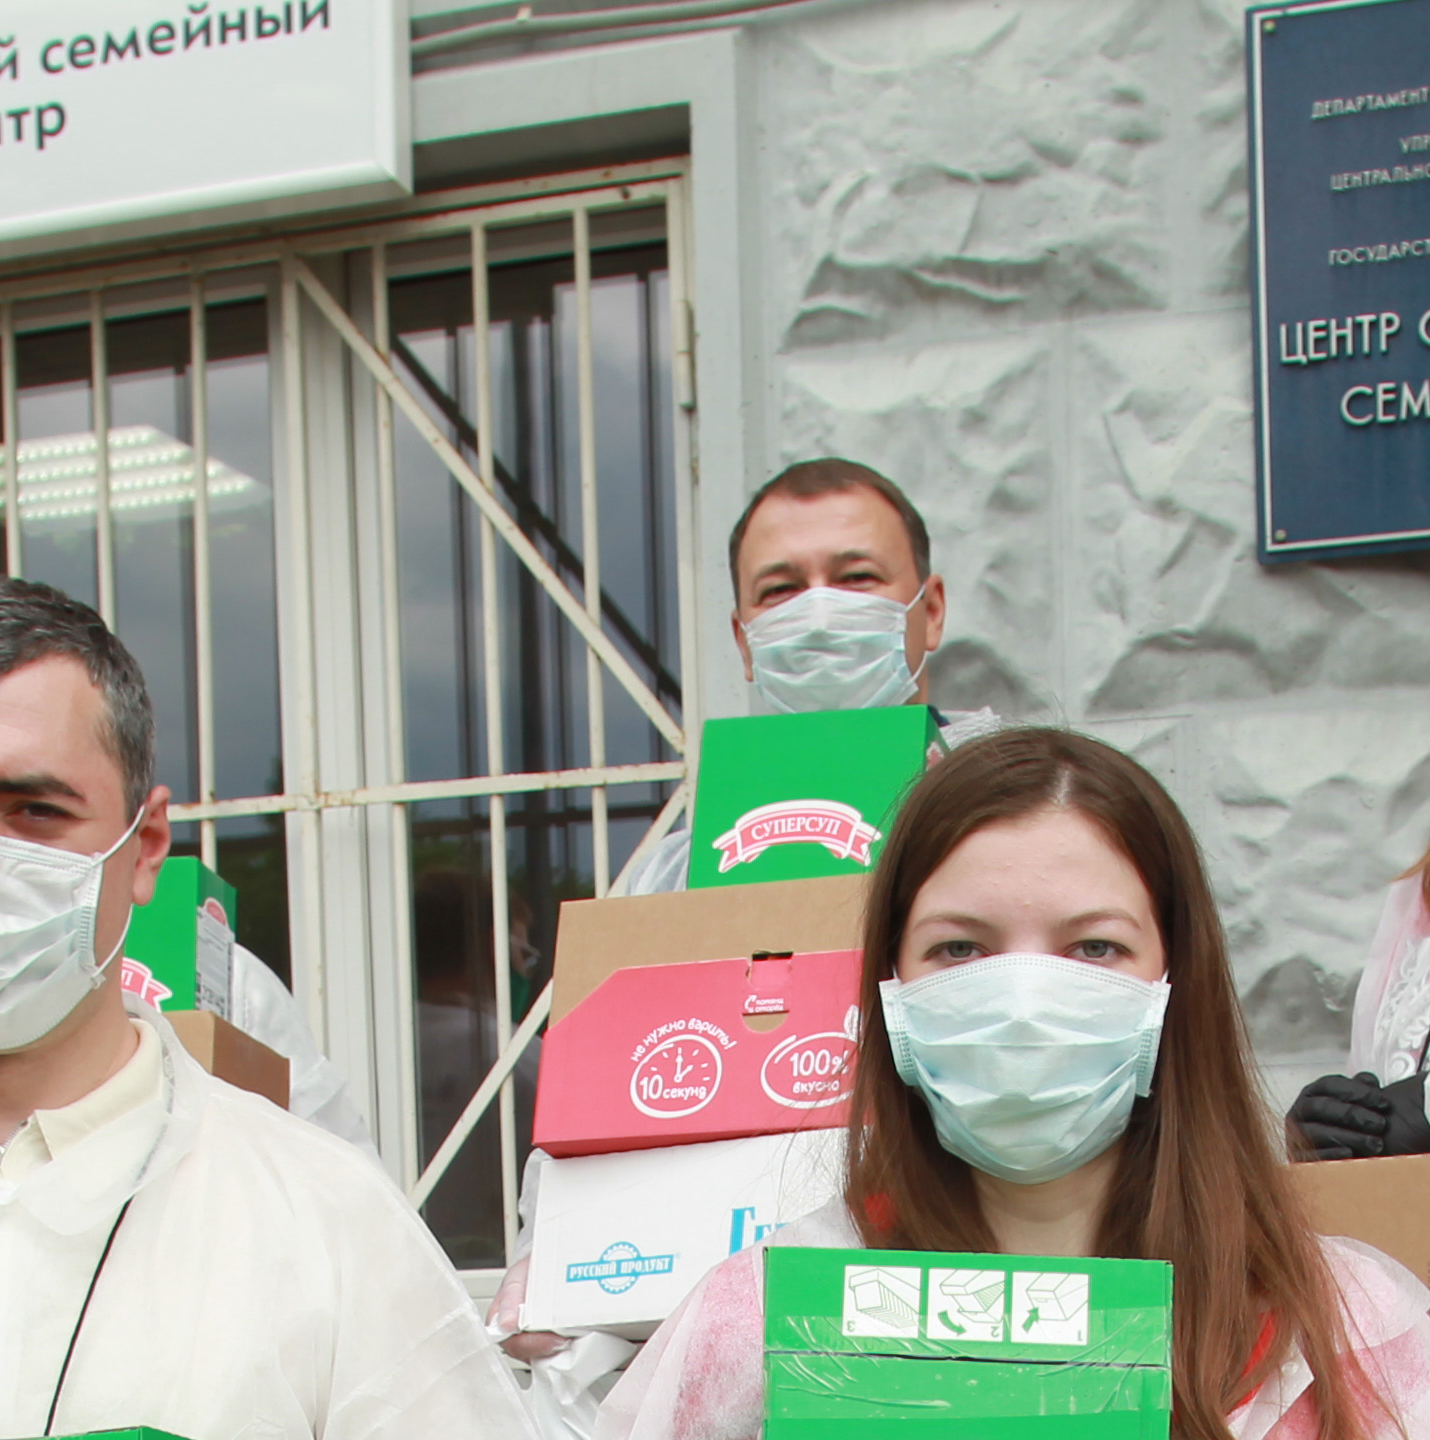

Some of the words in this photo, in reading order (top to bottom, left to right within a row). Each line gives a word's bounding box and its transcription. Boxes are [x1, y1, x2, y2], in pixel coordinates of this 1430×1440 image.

[40, 0, 331, 74] семейный
[1311, 86, 1430, 120] ДЕПАРТАМЕНТ
[1279, 311, 1402, 366] ЦЕНТР
[750, 815, 843, 841] СУПЕРСУП
[631, 1044, 646, 1063] не
[643, 1019, 686, 1045] нужно
[687, 1017, 738, 1051] варить!
[789, 1048, 850, 1077] 100%
[639, 1074, 664, 1100] 10
[662, 1085, 707, 1101] секунд
[792, 1079, 840, 1096] вкусно
[569, 1260, 617, 1280] РУССКИЙ
[620, 1256, 671, 1275] ПРОДУКТ
